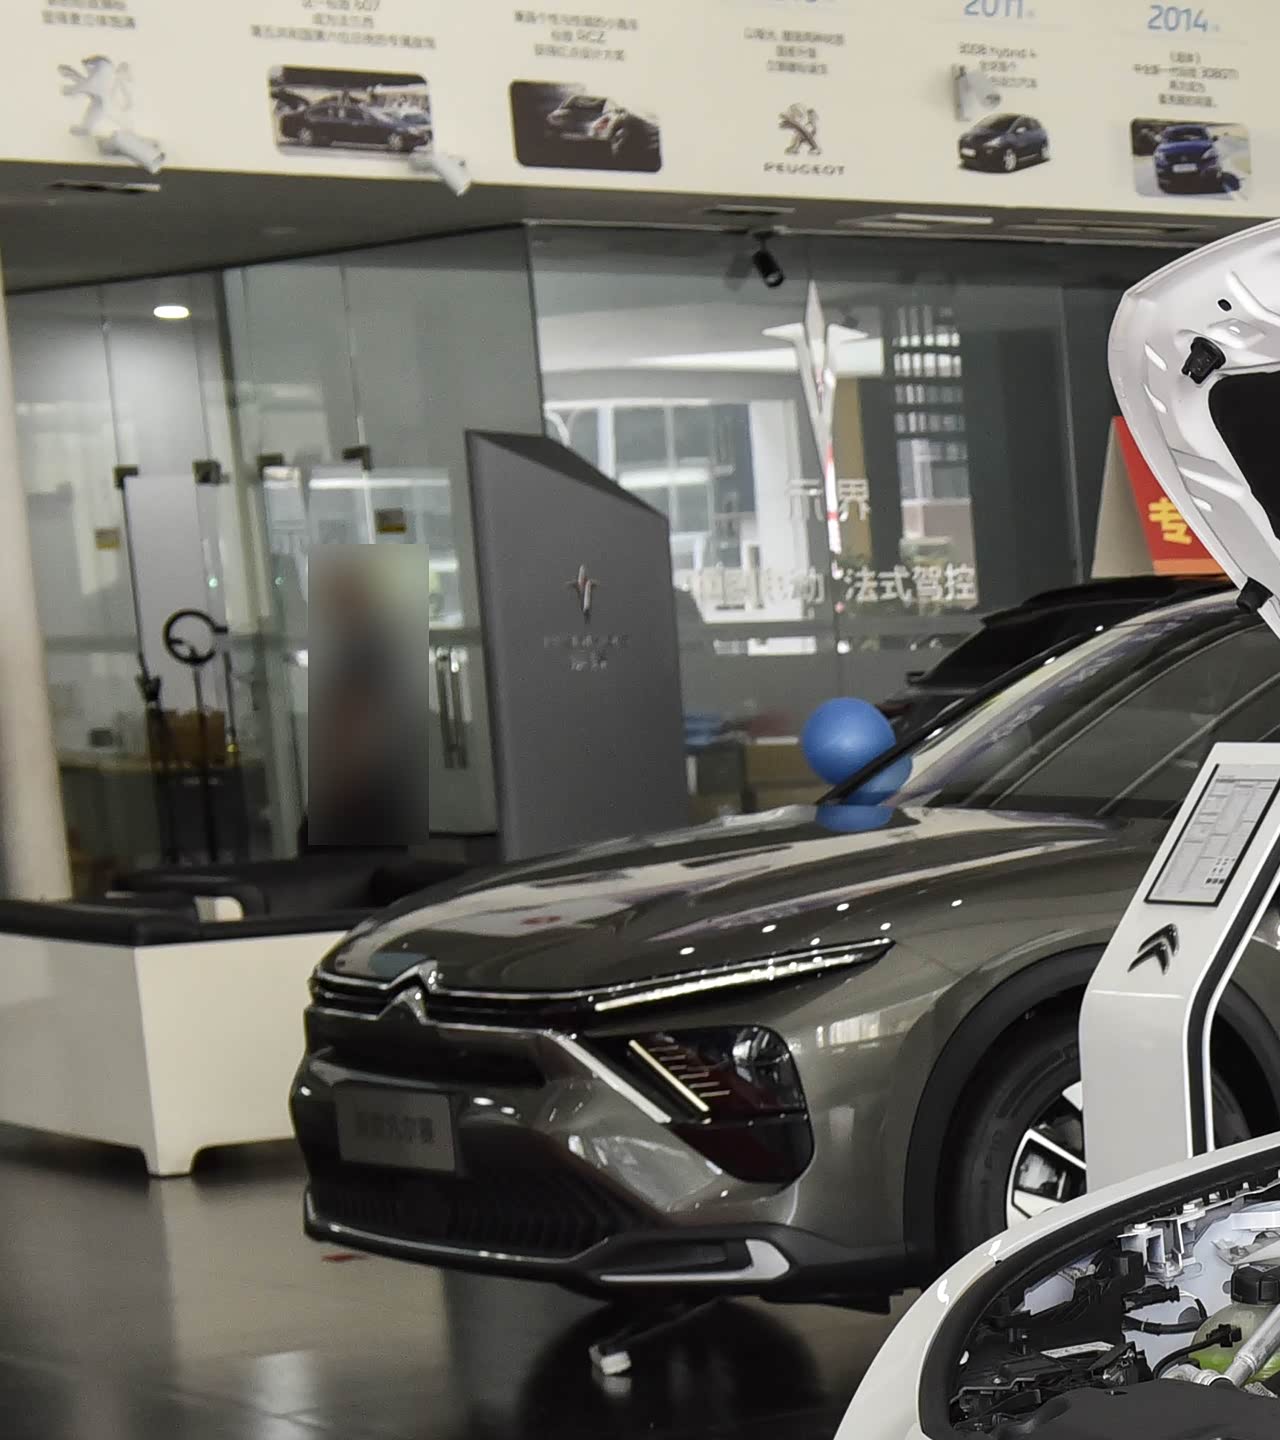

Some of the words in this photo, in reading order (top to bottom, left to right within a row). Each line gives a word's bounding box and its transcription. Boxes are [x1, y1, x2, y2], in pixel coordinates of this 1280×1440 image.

[763, 161, 846, 177] PEUGEOT
[845, 563, 977, 608] 法式驾控
